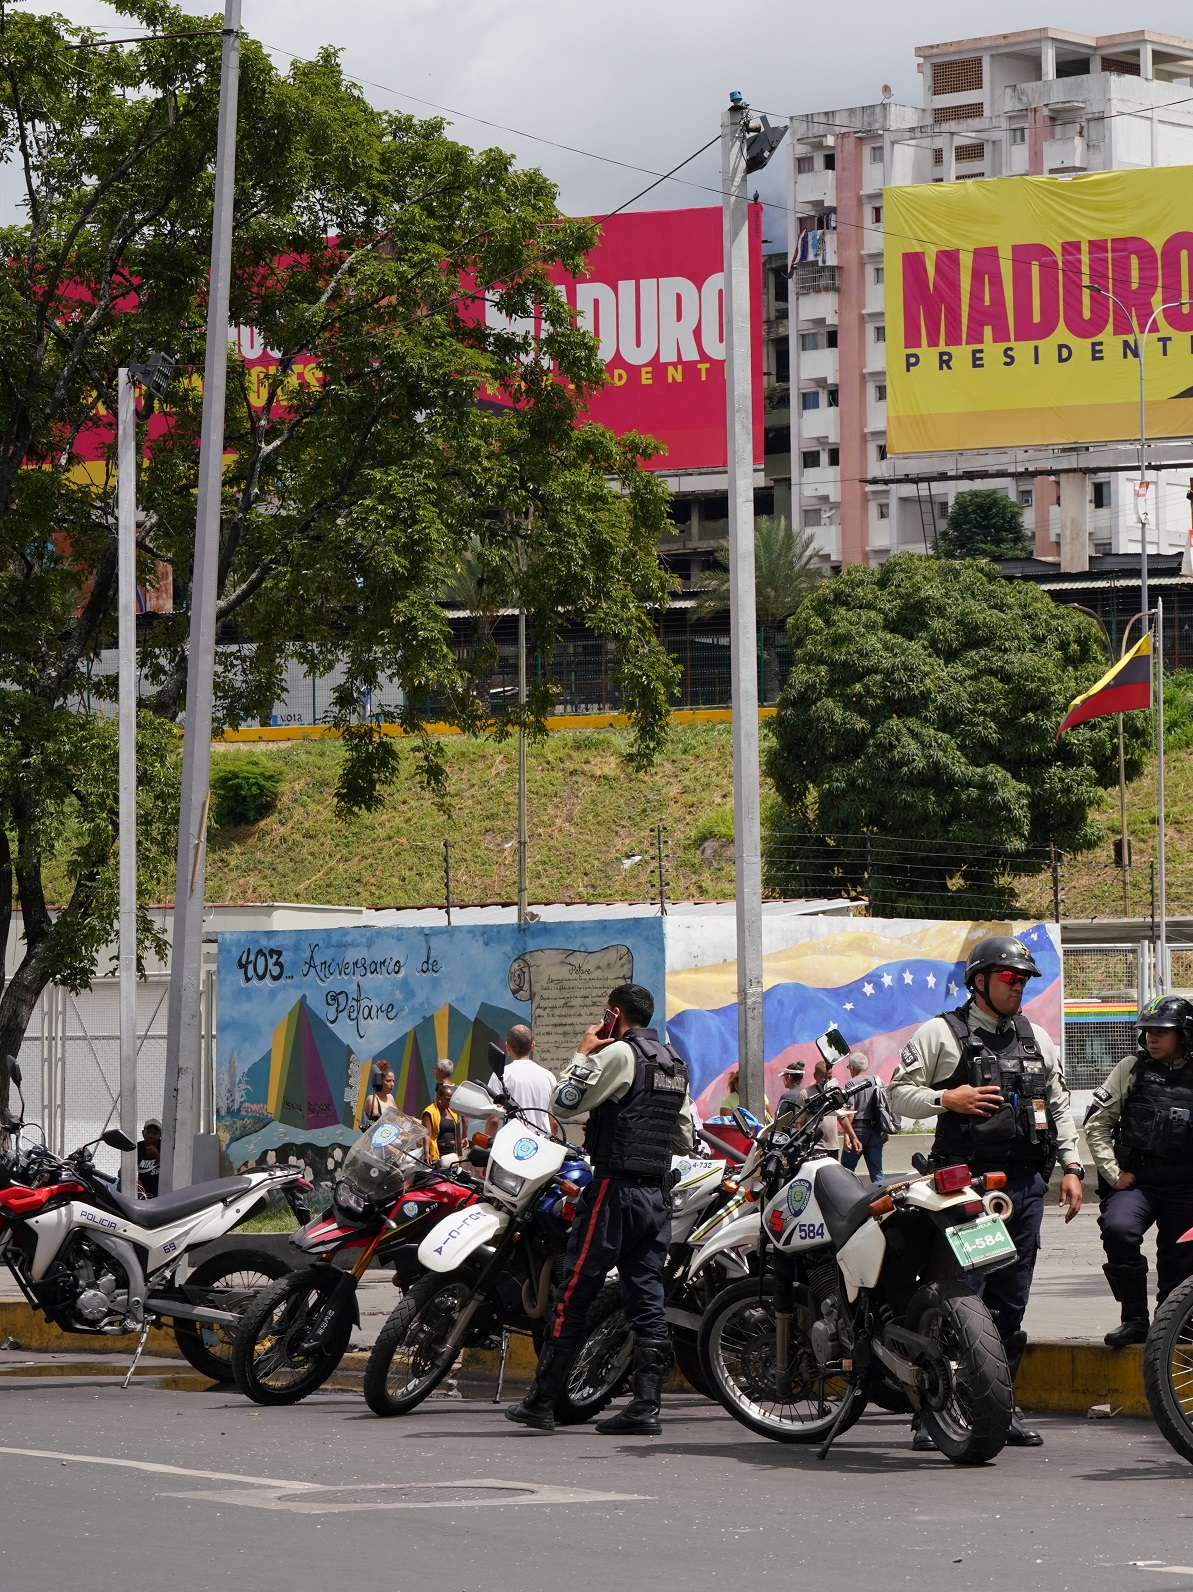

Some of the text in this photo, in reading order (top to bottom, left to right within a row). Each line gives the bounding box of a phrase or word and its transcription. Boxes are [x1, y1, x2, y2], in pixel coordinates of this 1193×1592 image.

[302, 943, 409, 983] Aniversario
[418, 944, 444, 976] de
[325, 981, 404, 1040] Petare
[139, 1159, 157, 1169] NIKE
[80, 1210, 118, 1231] POLICIA
[798, 1222, 825, 1240] 584
[433, 1211, 487, 1256] POLICIA
[962, 1231, 1005, 1253] 4-584
[162, 1242, 177, 1254] 69
